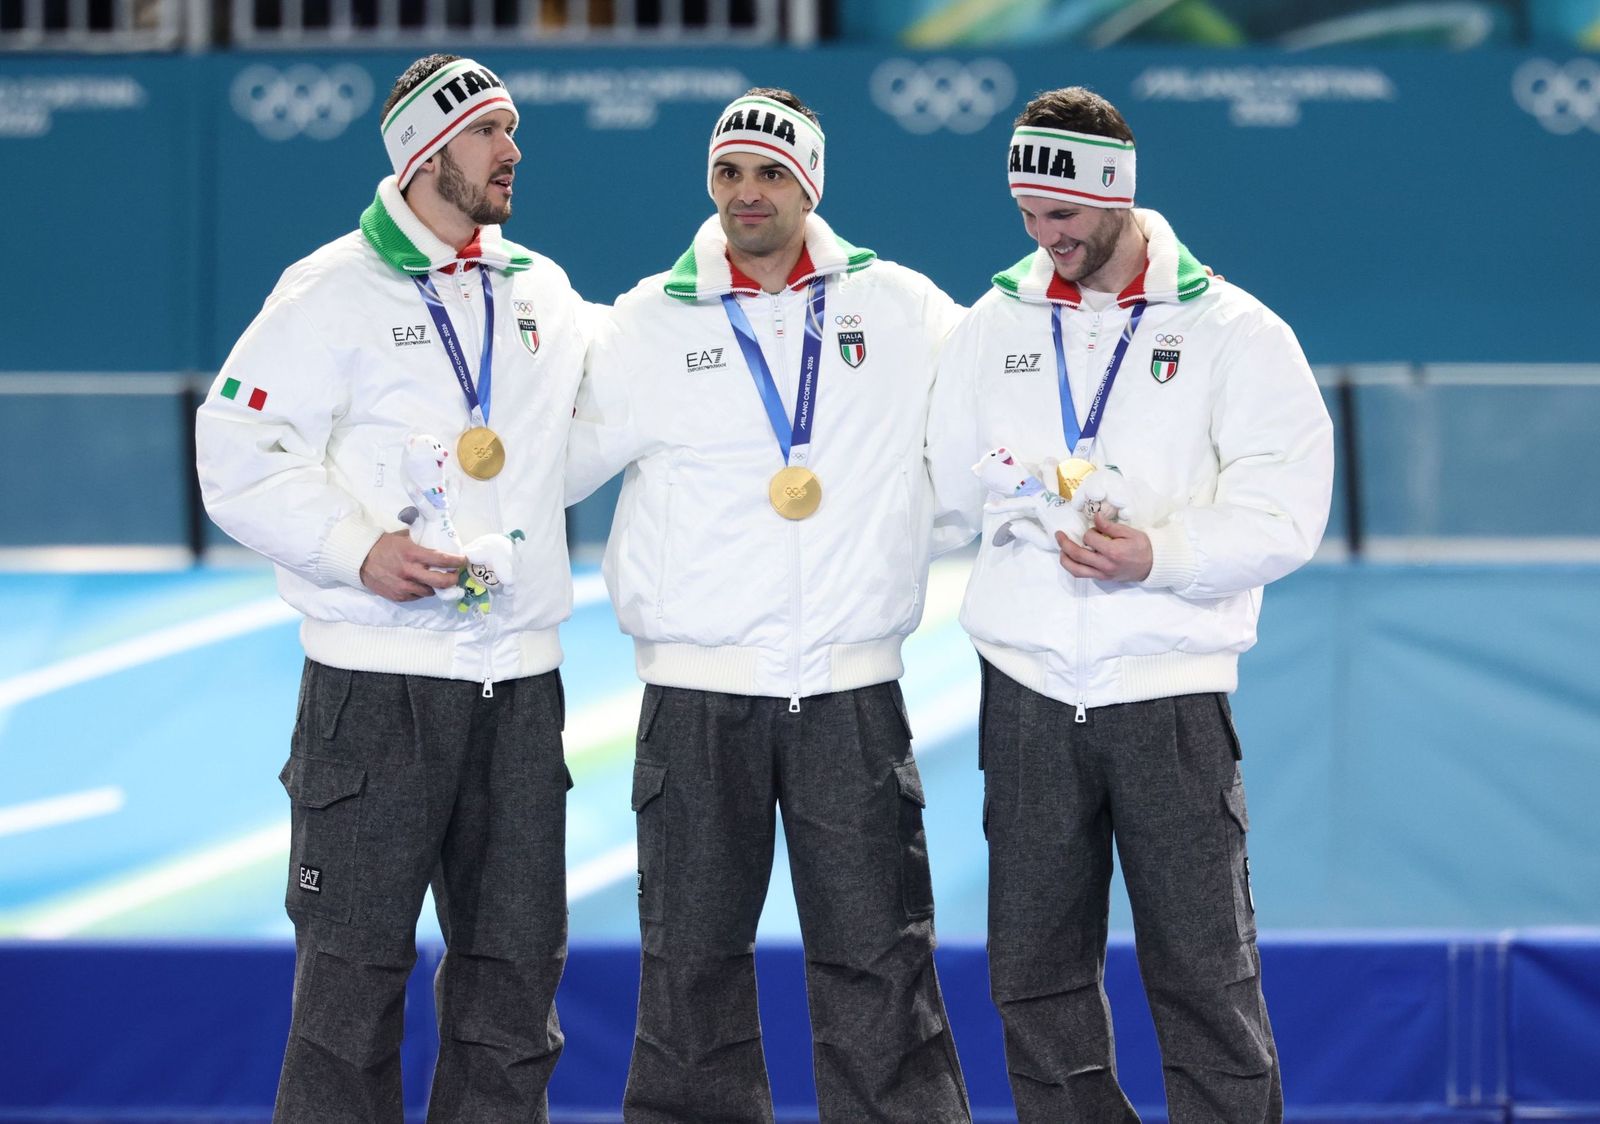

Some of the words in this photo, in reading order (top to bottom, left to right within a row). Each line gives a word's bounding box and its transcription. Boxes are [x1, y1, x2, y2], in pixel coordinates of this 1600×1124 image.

[433, 69, 505, 115] ITAL
[400, 124, 414, 144] EA7
[1009, 145, 1076, 180] ALIA
[392, 325, 427, 342] EA7
[839, 332, 862, 340] ITALIA
[447, 338, 462, 366] CORTINA
[686, 347, 724, 368] EA7
[1005, 353, 1042, 369] EA7
[1154, 350, 1178, 358] ITALIA
[458, 366, 471, 393] MILANO
[803, 371, 812, 401] CORTINA
[800, 401, 809, 430] MILANO
[1089, 395, 1101, 424] MILANO
[301, 867, 320, 885] EA7
